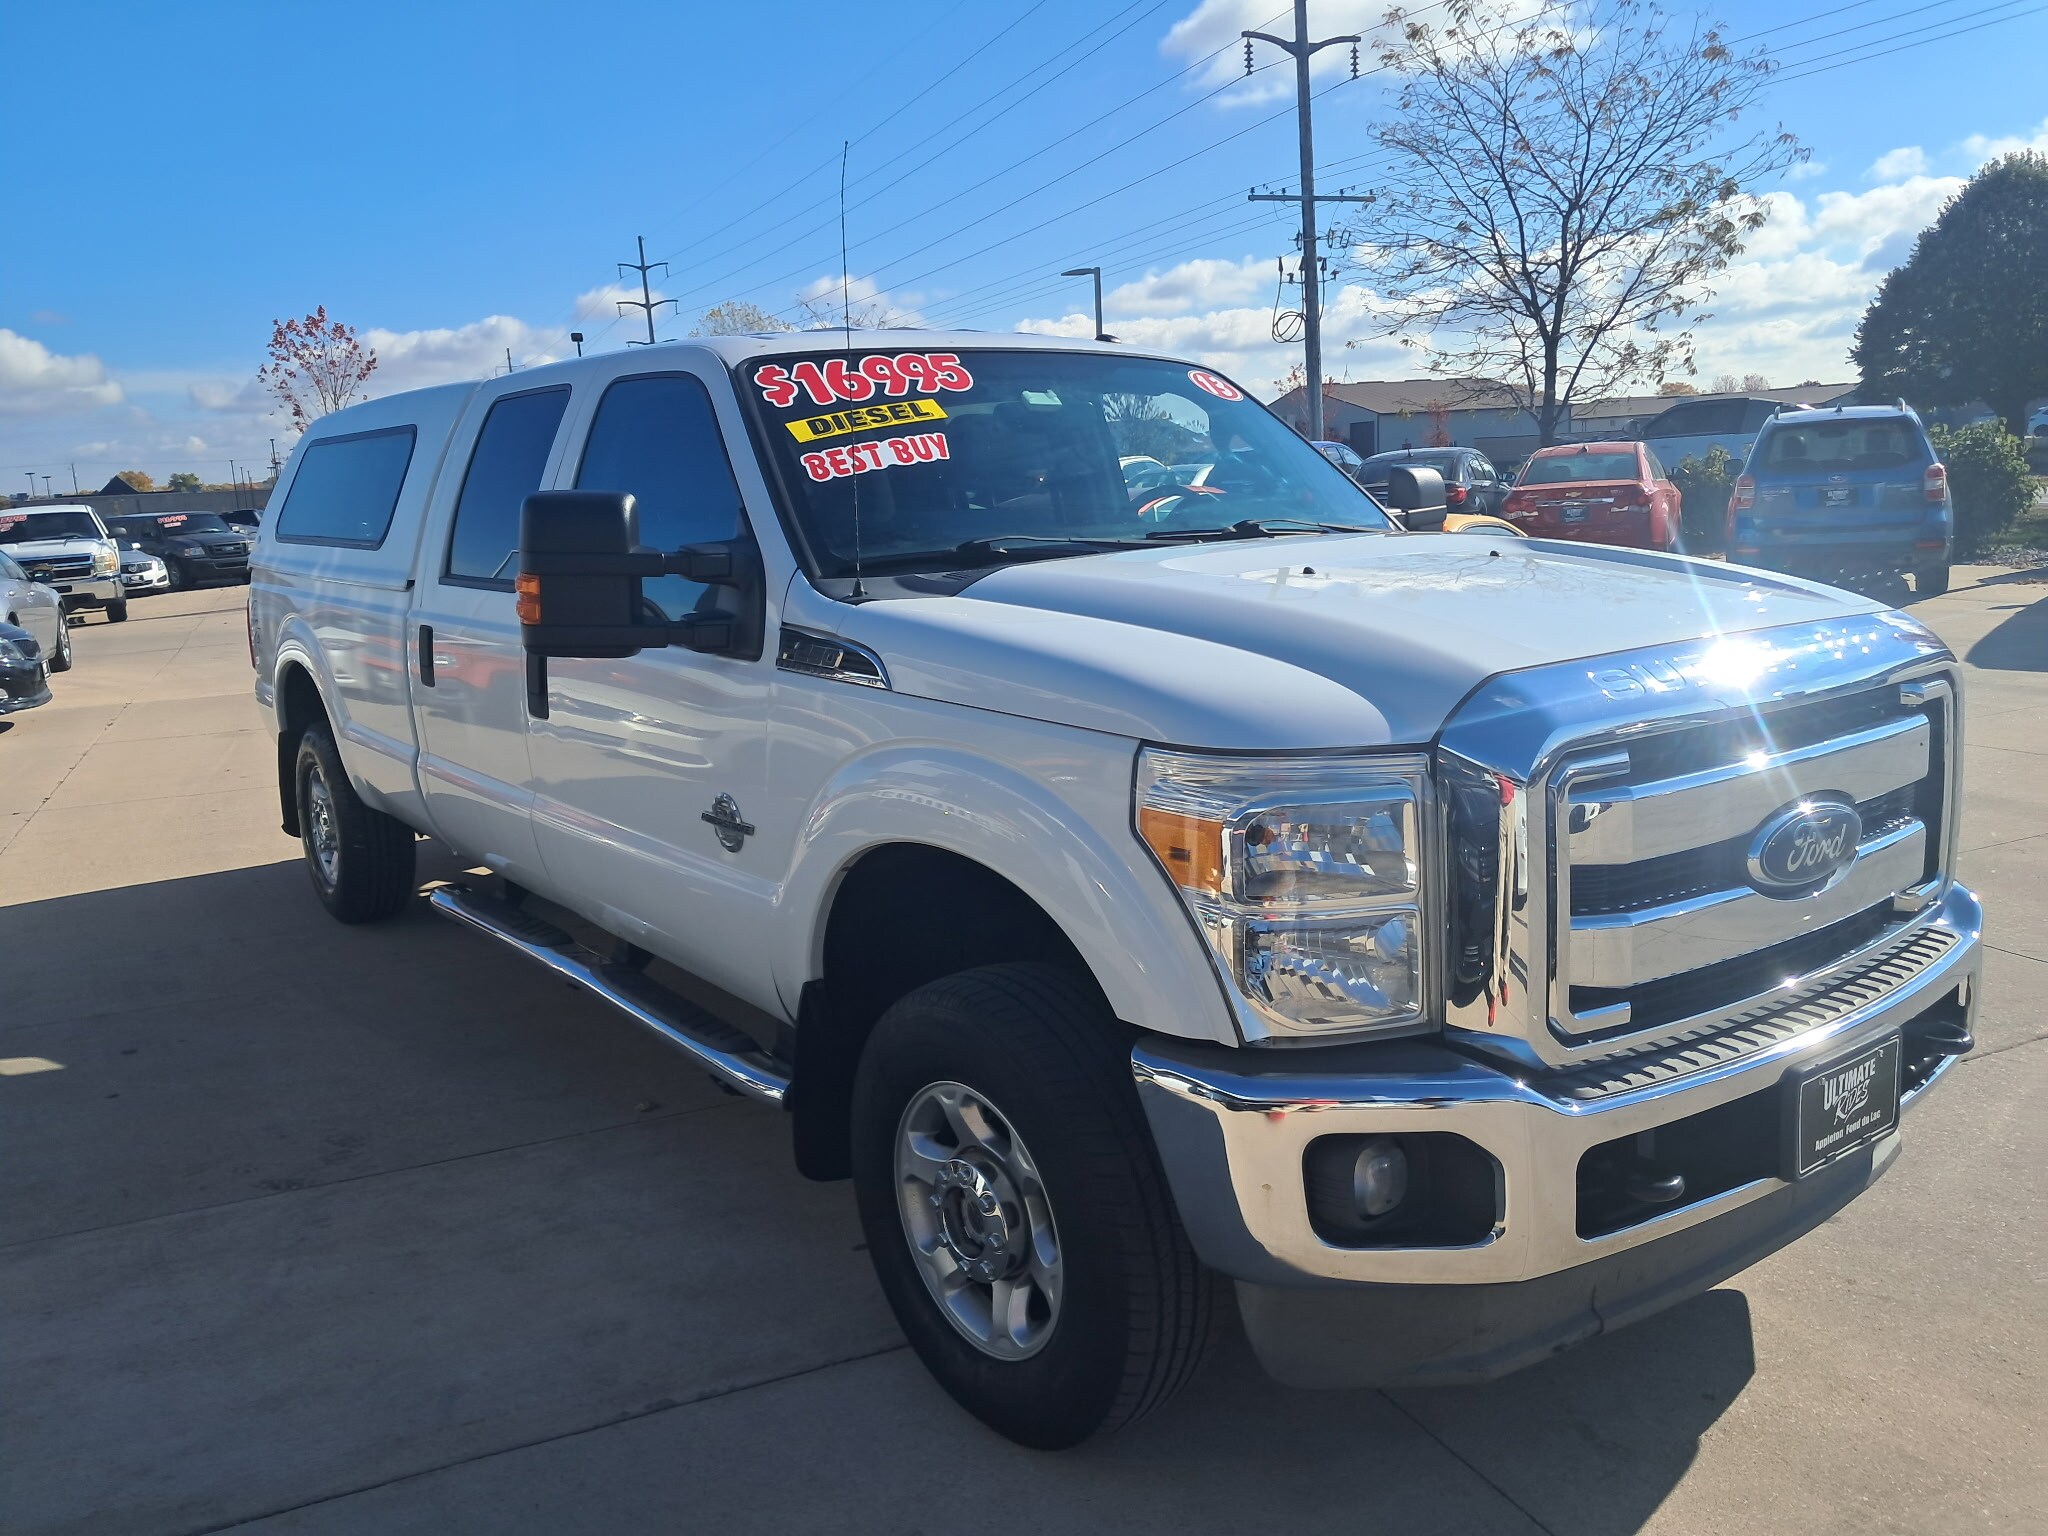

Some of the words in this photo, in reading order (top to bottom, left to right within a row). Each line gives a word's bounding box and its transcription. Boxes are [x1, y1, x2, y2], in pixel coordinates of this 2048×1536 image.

[754, 353, 974, 407] $16995
[1195, 373, 1233, 397] 13
[806, 401, 934, 437] DIESEL
[803, 444, 883, 481] BEST
[887, 433, 949, 464] BUY
[1787, 818, 1847, 872] Ford
[1823, 1057, 1876, 1111] ULTIMATE
[1815, 1129, 1844, 1151] Appleton
[1845, 1119, 1861, 1135] Fond
[1861, 1115, 1870, 1127] du
[1870, 1109, 1881, 1122] Lac
